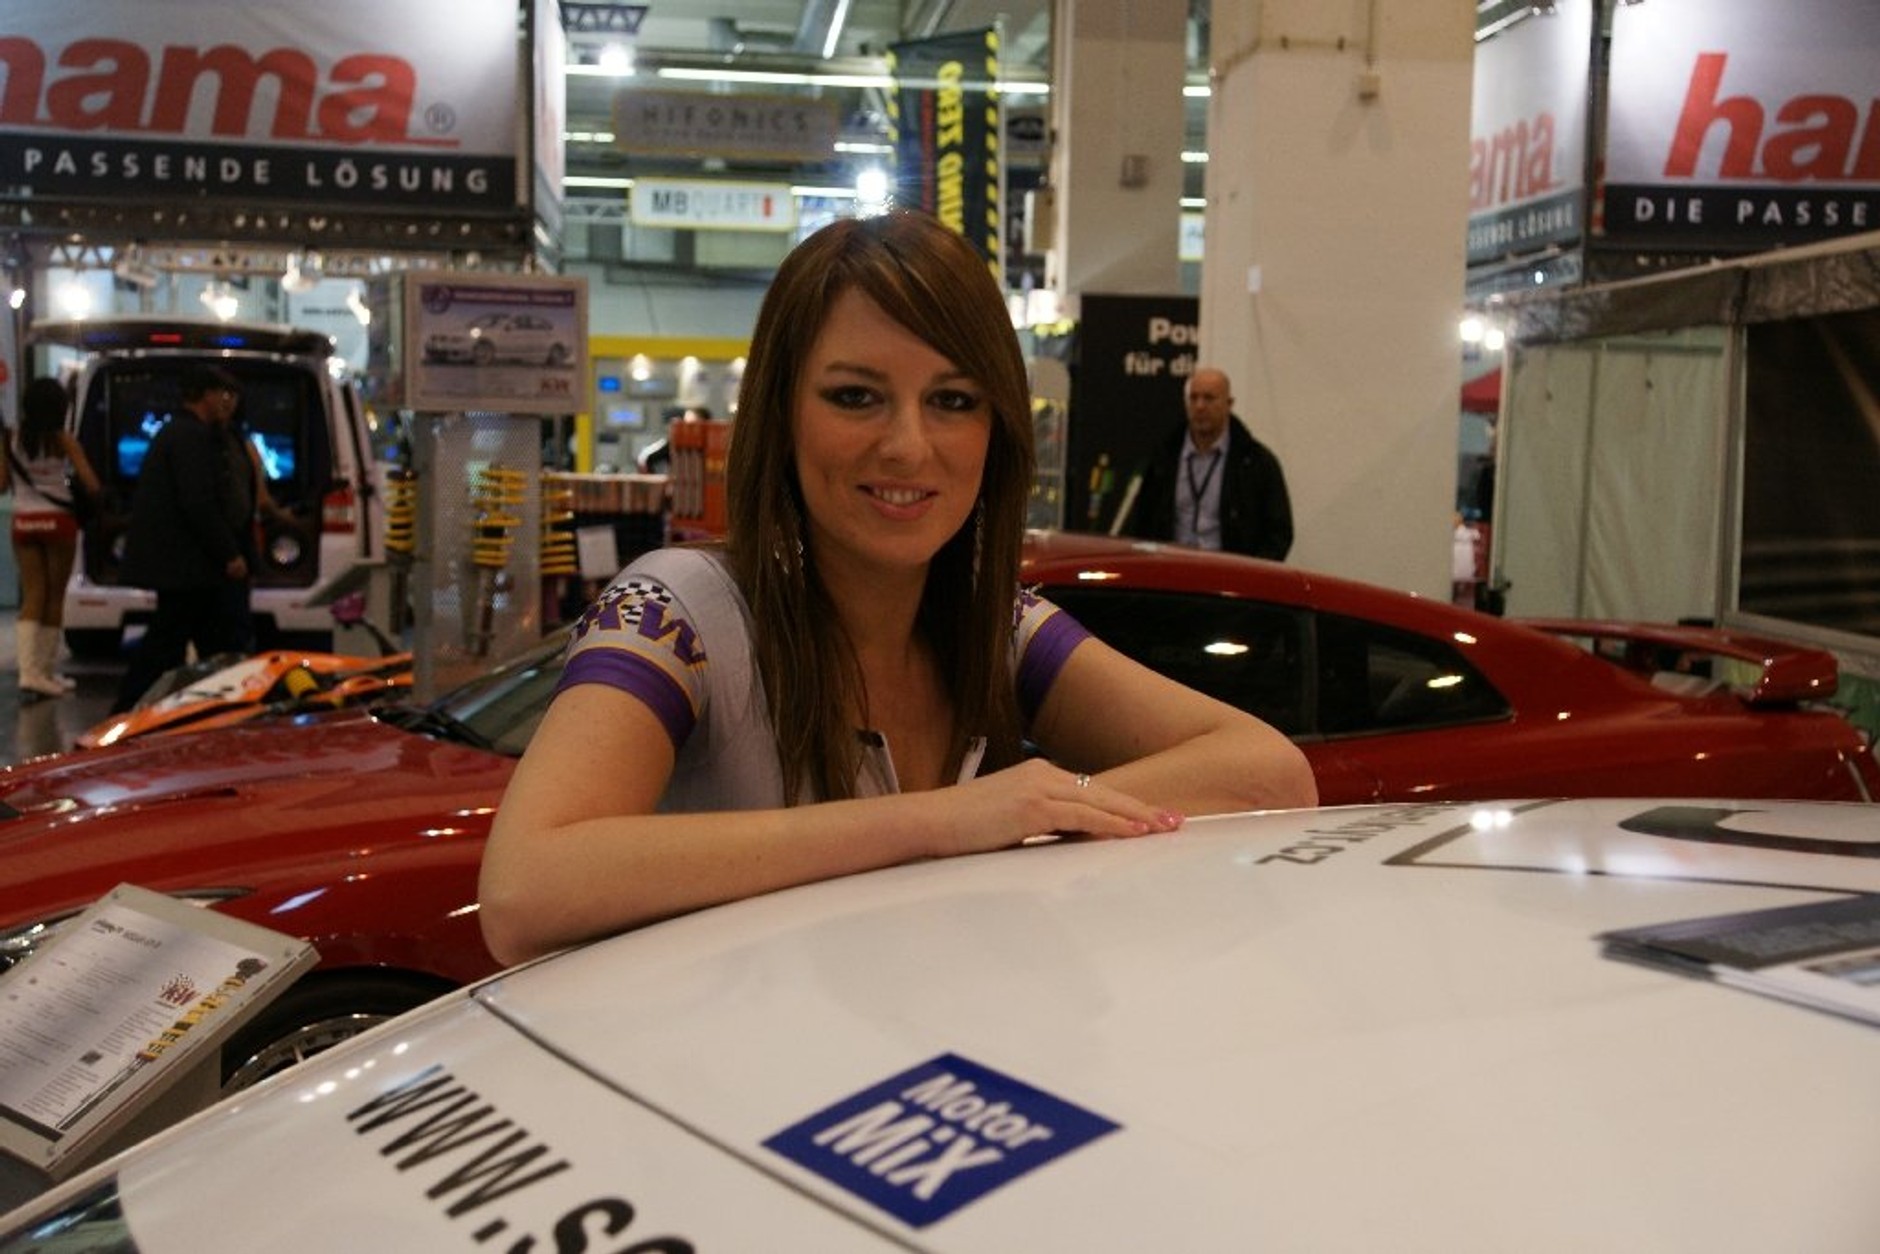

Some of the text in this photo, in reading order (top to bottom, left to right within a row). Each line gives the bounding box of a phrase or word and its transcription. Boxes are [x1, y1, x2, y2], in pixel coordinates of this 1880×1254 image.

[1663, 53, 1880, 182] ha
[24, 148, 488, 192] PASSENDE LÖSUNG
[1634, 198, 1704, 222] DIE
[1125, 352, 1163, 375] für
[901, 1073, 1054, 1149] Motor
